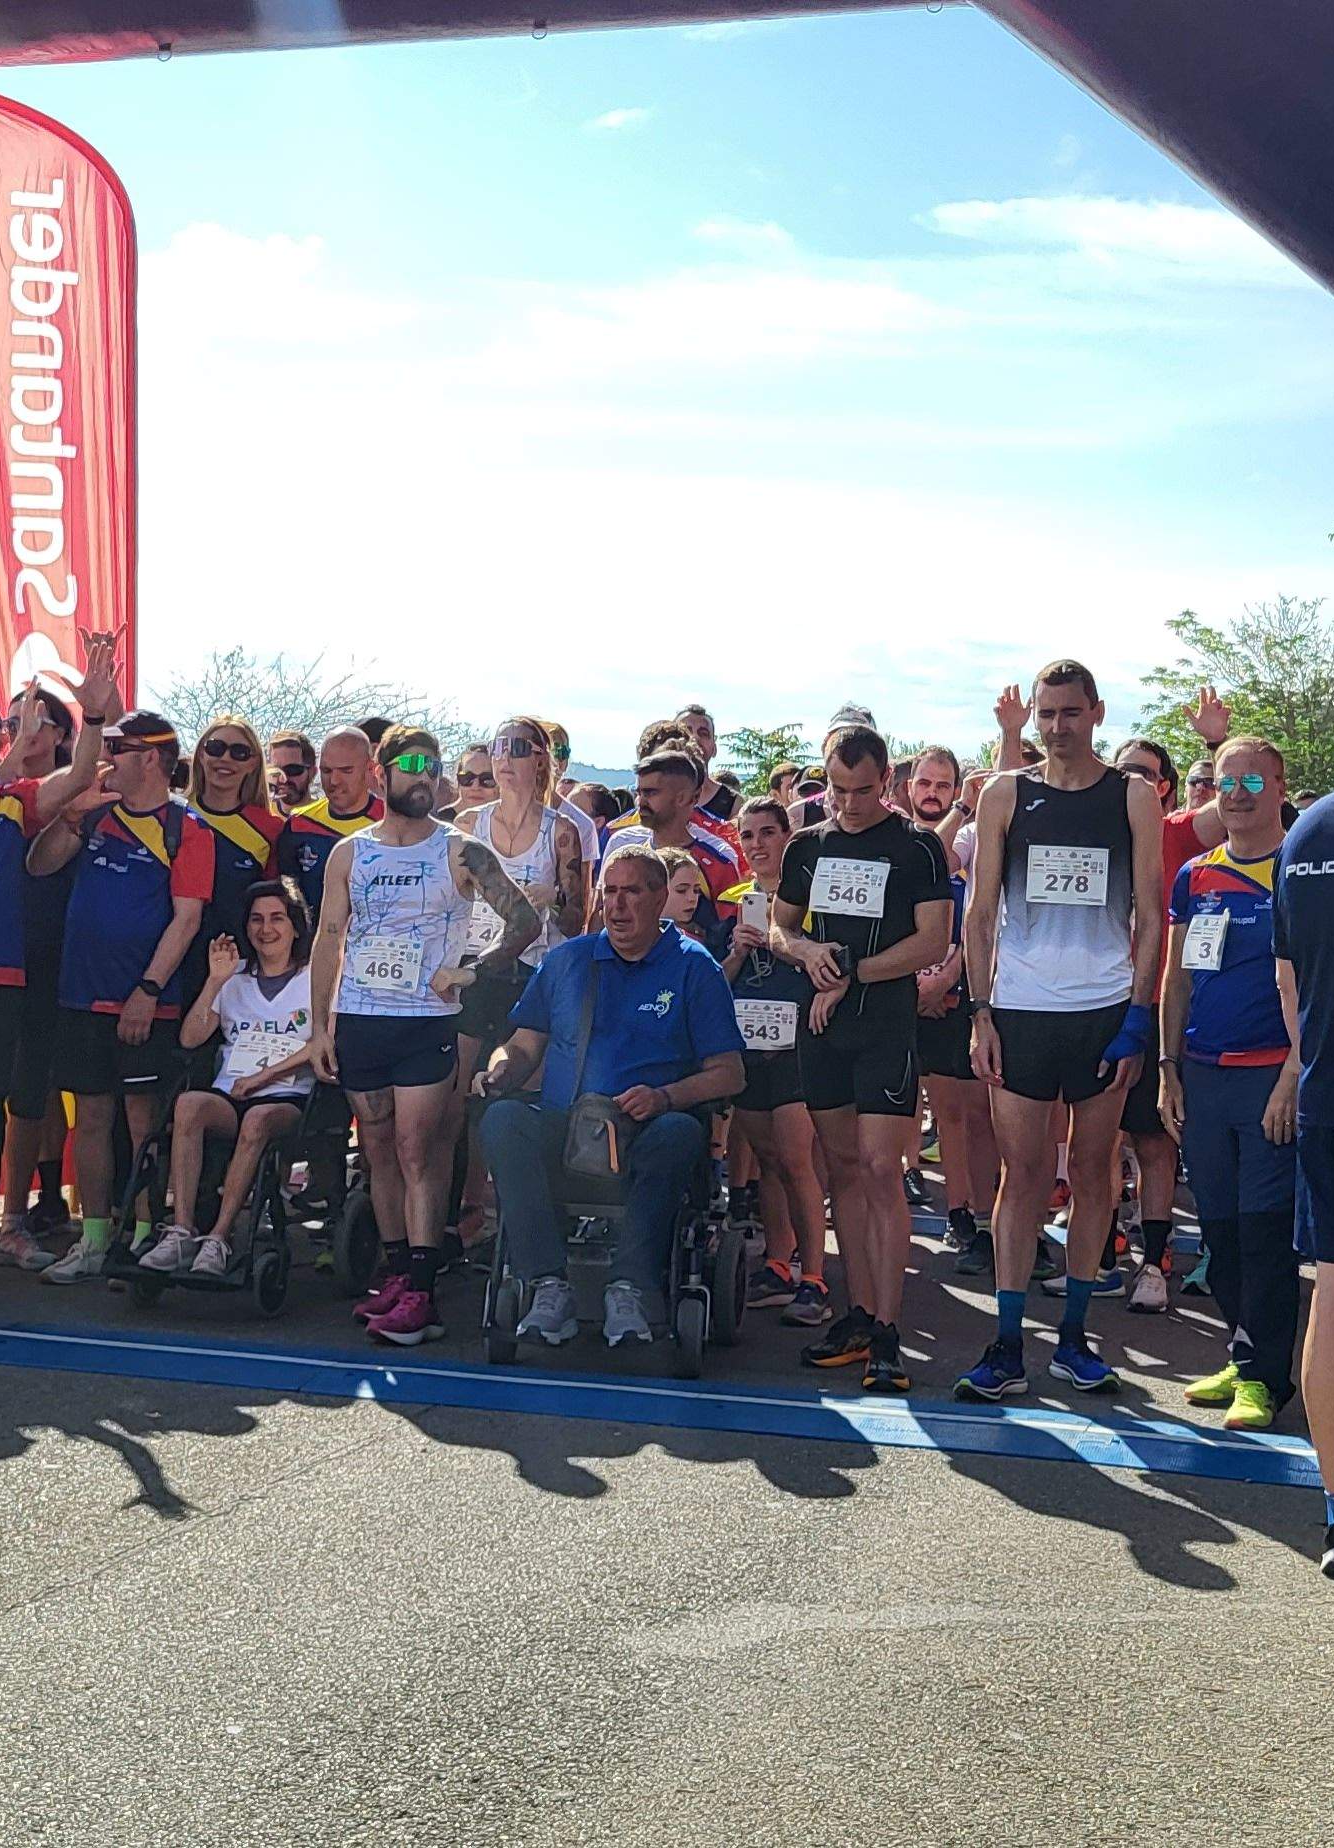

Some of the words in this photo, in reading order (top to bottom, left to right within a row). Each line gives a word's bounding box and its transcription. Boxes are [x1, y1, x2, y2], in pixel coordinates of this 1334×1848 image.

[370, 874, 423, 886] ATLEET
[1044, 873, 1089, 893] 278
[827, 885, 868, 905] 546
[1198, 941, 1212, 959] 3
[365, 960, 404, 980] 466
[743, 1023, 780, 1041] 543
